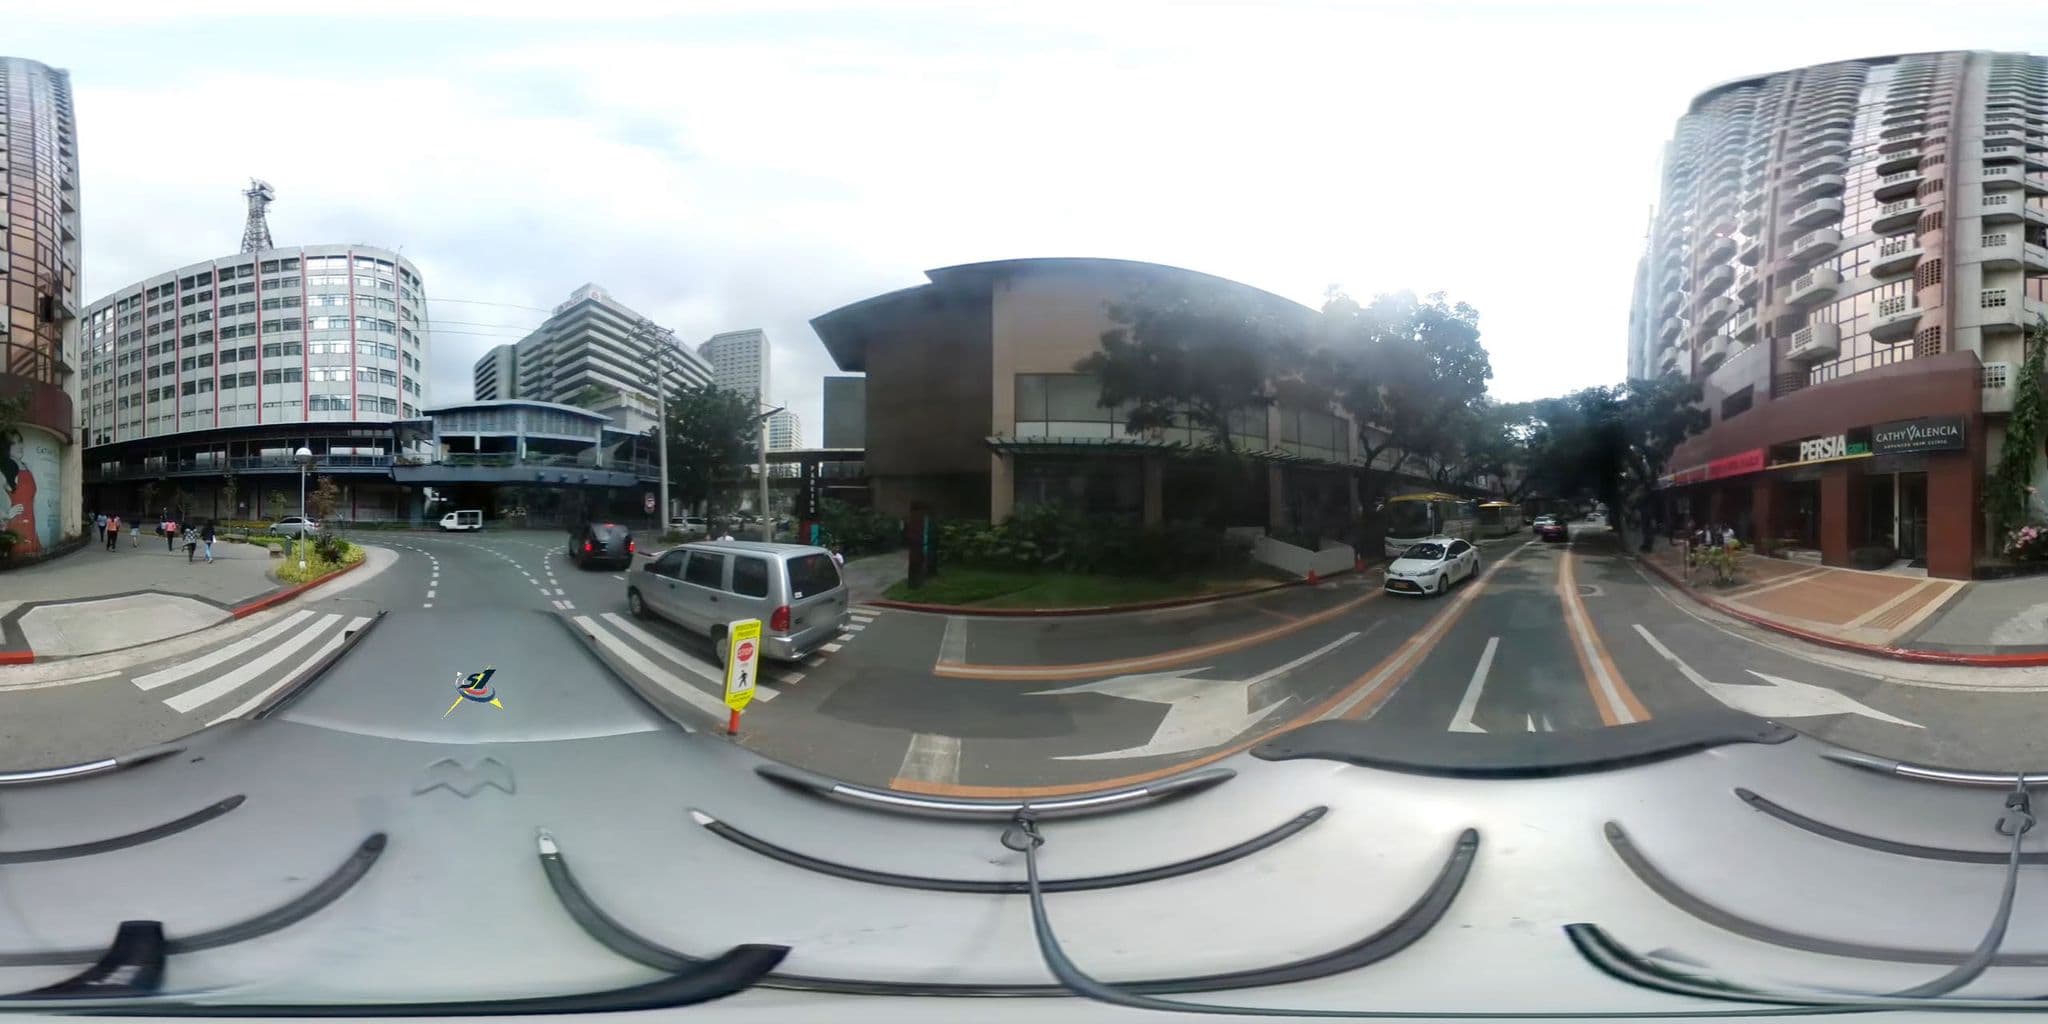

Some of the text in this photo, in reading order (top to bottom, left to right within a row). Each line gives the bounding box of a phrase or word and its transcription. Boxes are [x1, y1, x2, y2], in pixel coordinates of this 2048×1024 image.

[1876, 424, 1958, 443] CATHY VALENCIA
[1799, 434, 1846, 462] PERSIA
